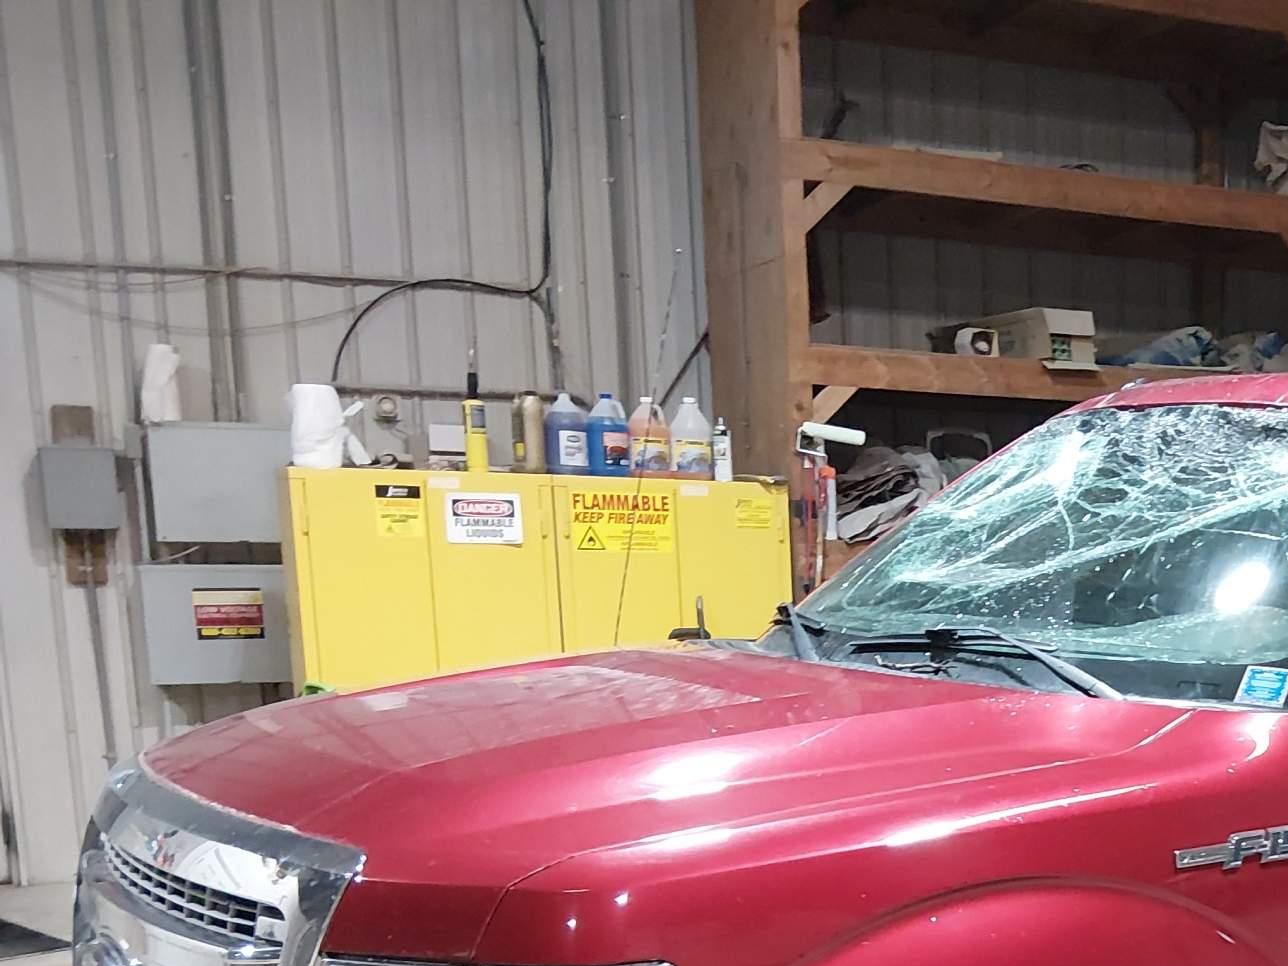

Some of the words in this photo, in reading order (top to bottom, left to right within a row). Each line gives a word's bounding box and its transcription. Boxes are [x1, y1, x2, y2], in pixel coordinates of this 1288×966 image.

[457, 503, 509, 514] DANGER
[572, 493, 670, 512] FLAMMABLE
[454, 517, 515, 528] FLAMMABLE
[573, 511, 604, 523] KEEP
[607, 512, 635, 525] FIRE
[636, 513, 669, 525] AWAY
